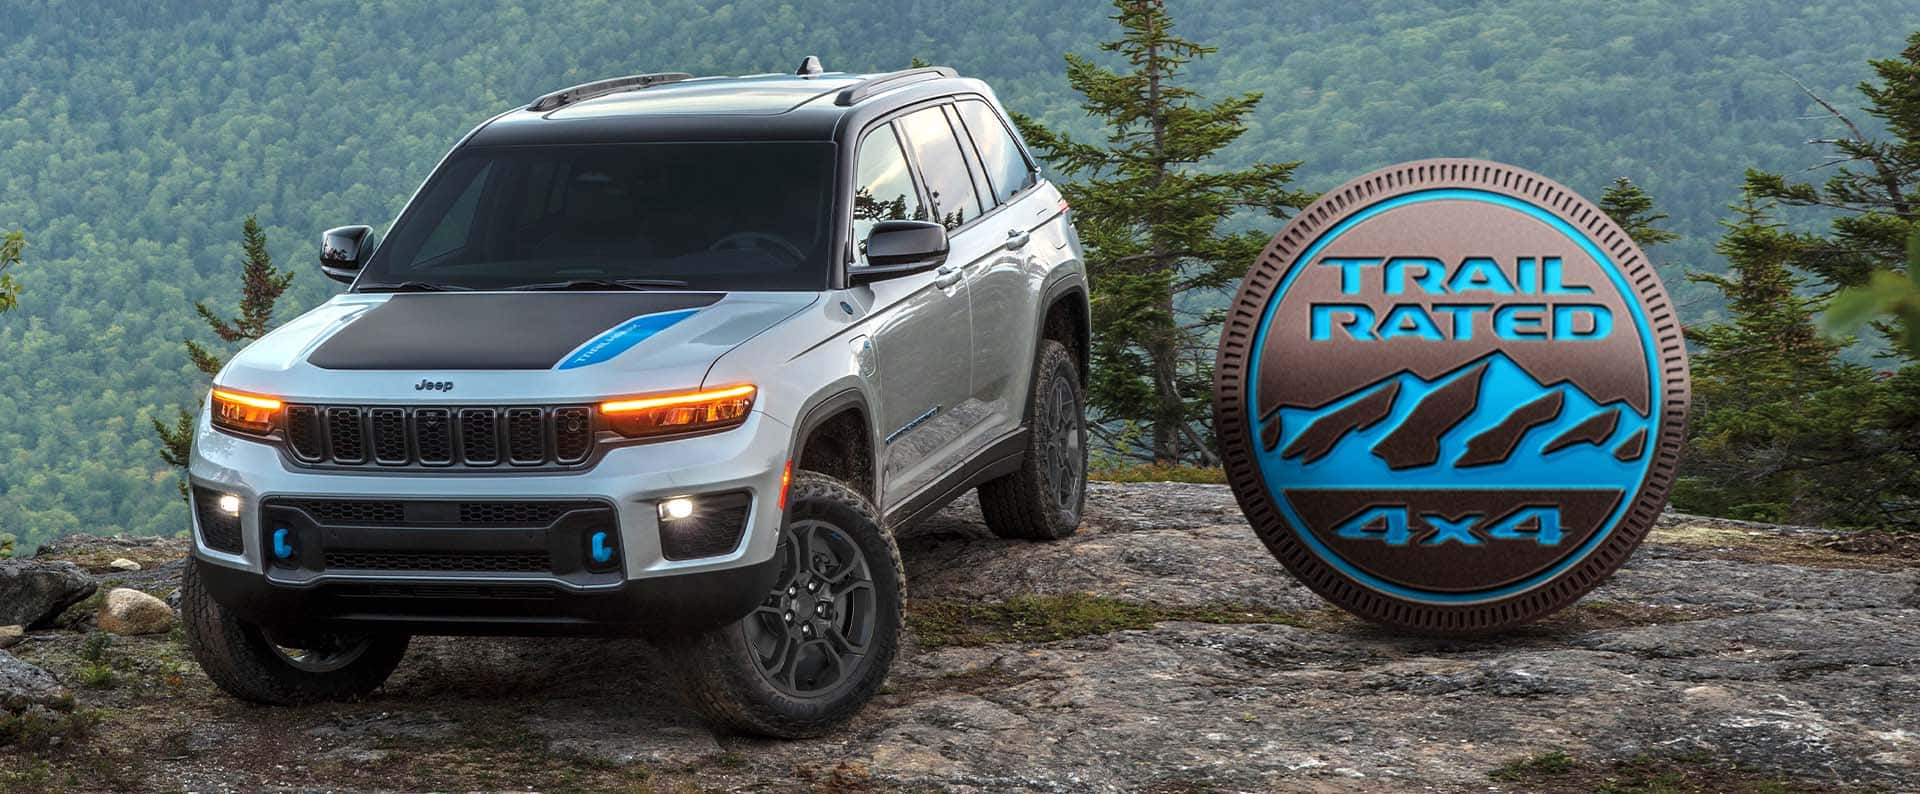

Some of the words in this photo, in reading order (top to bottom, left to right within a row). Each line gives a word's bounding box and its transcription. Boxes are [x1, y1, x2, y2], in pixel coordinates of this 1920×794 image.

[1317, 256, 1595, 296] TRAIL
[1309, 302, 1615, 342] RATED
[415, 379, 454, 393] Jeep
[1331, 504, 1572, 545] 4x4
